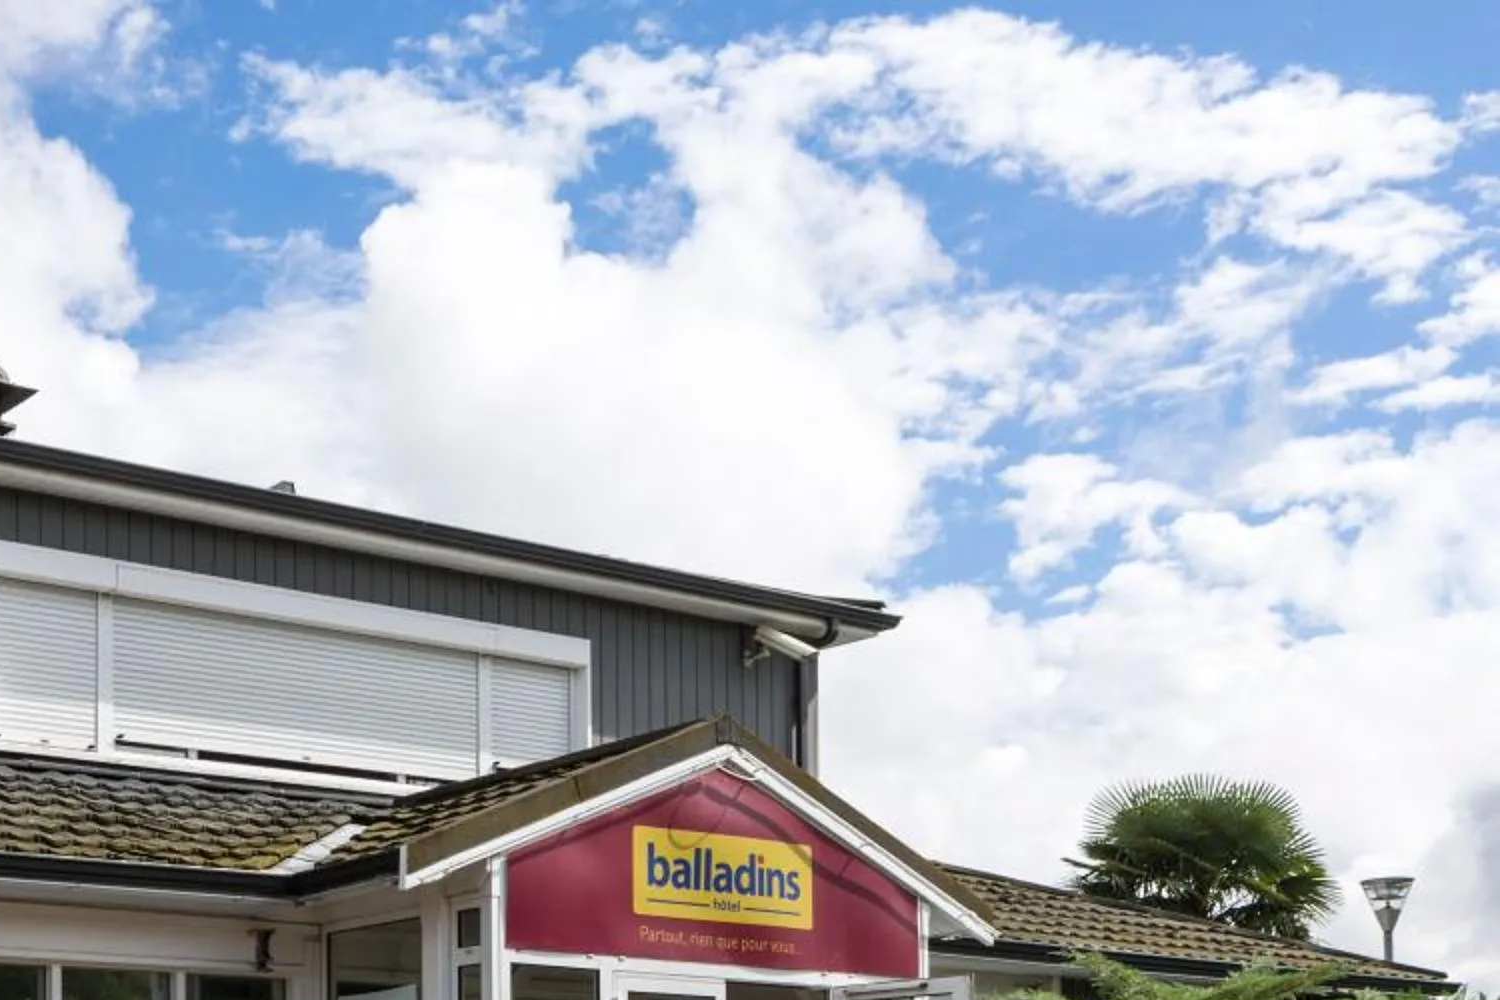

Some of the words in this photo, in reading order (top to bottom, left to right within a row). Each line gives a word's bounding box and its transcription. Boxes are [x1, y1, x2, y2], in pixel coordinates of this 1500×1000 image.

[646, 842, 801, 901] balladins
[713, 898, 741, 912] hôtel
[639, 925, 687, 946] Partout,
[690, 932, 713, 945] rien
[716, 936, 740, 951] que
[741, 939, 769, 952] pour
